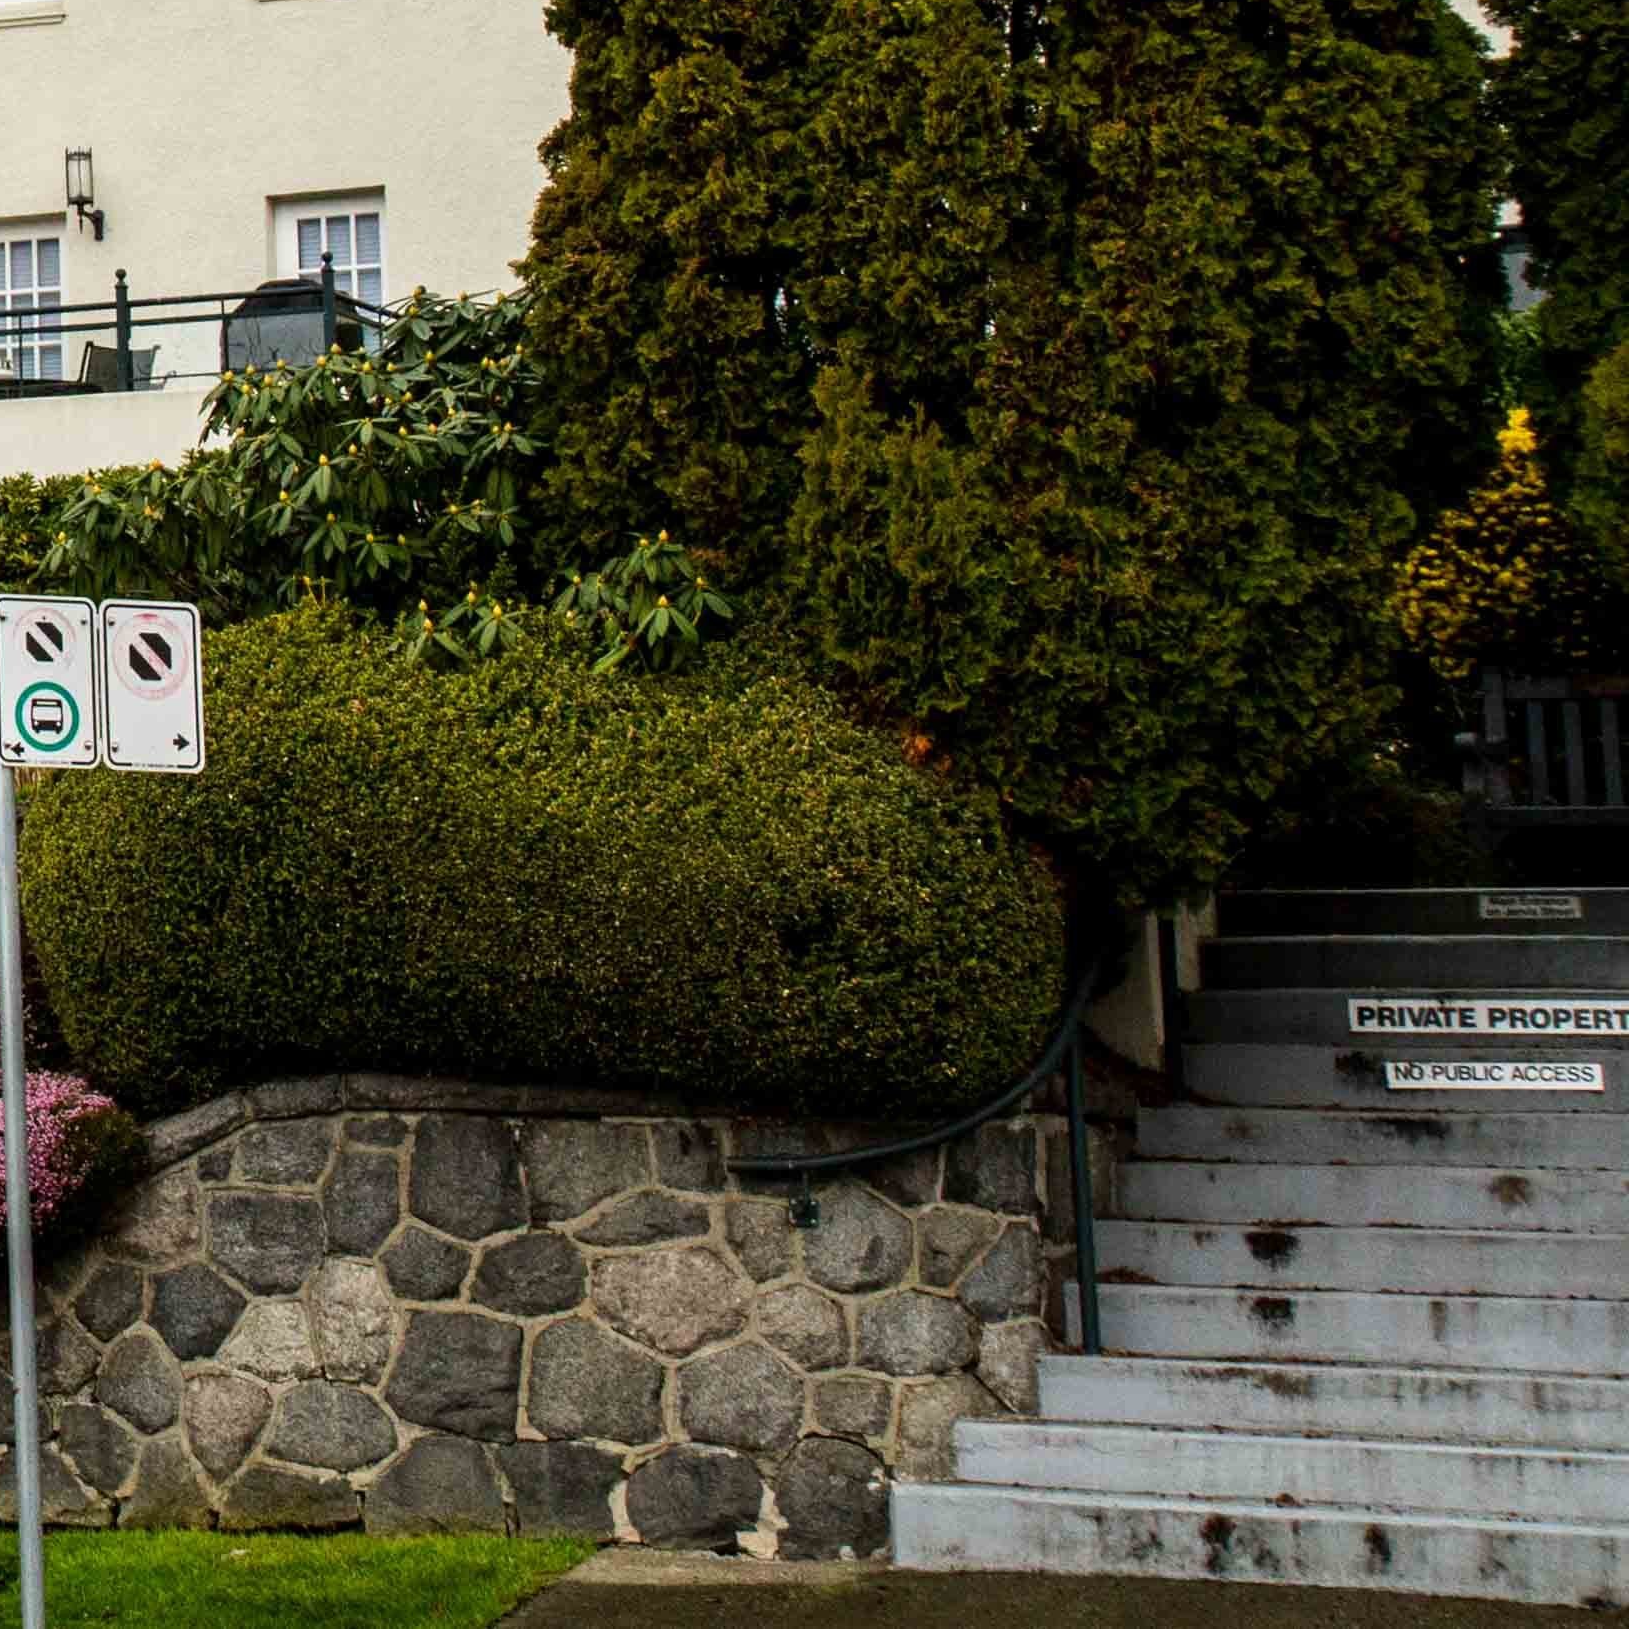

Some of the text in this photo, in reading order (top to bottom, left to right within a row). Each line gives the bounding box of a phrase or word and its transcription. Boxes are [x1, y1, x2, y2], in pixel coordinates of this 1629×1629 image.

[1356, 1006, 1477, 1029] PRIVATE
[1394, 1065, 1595, 1082] NO PUBLIC ACCESS
